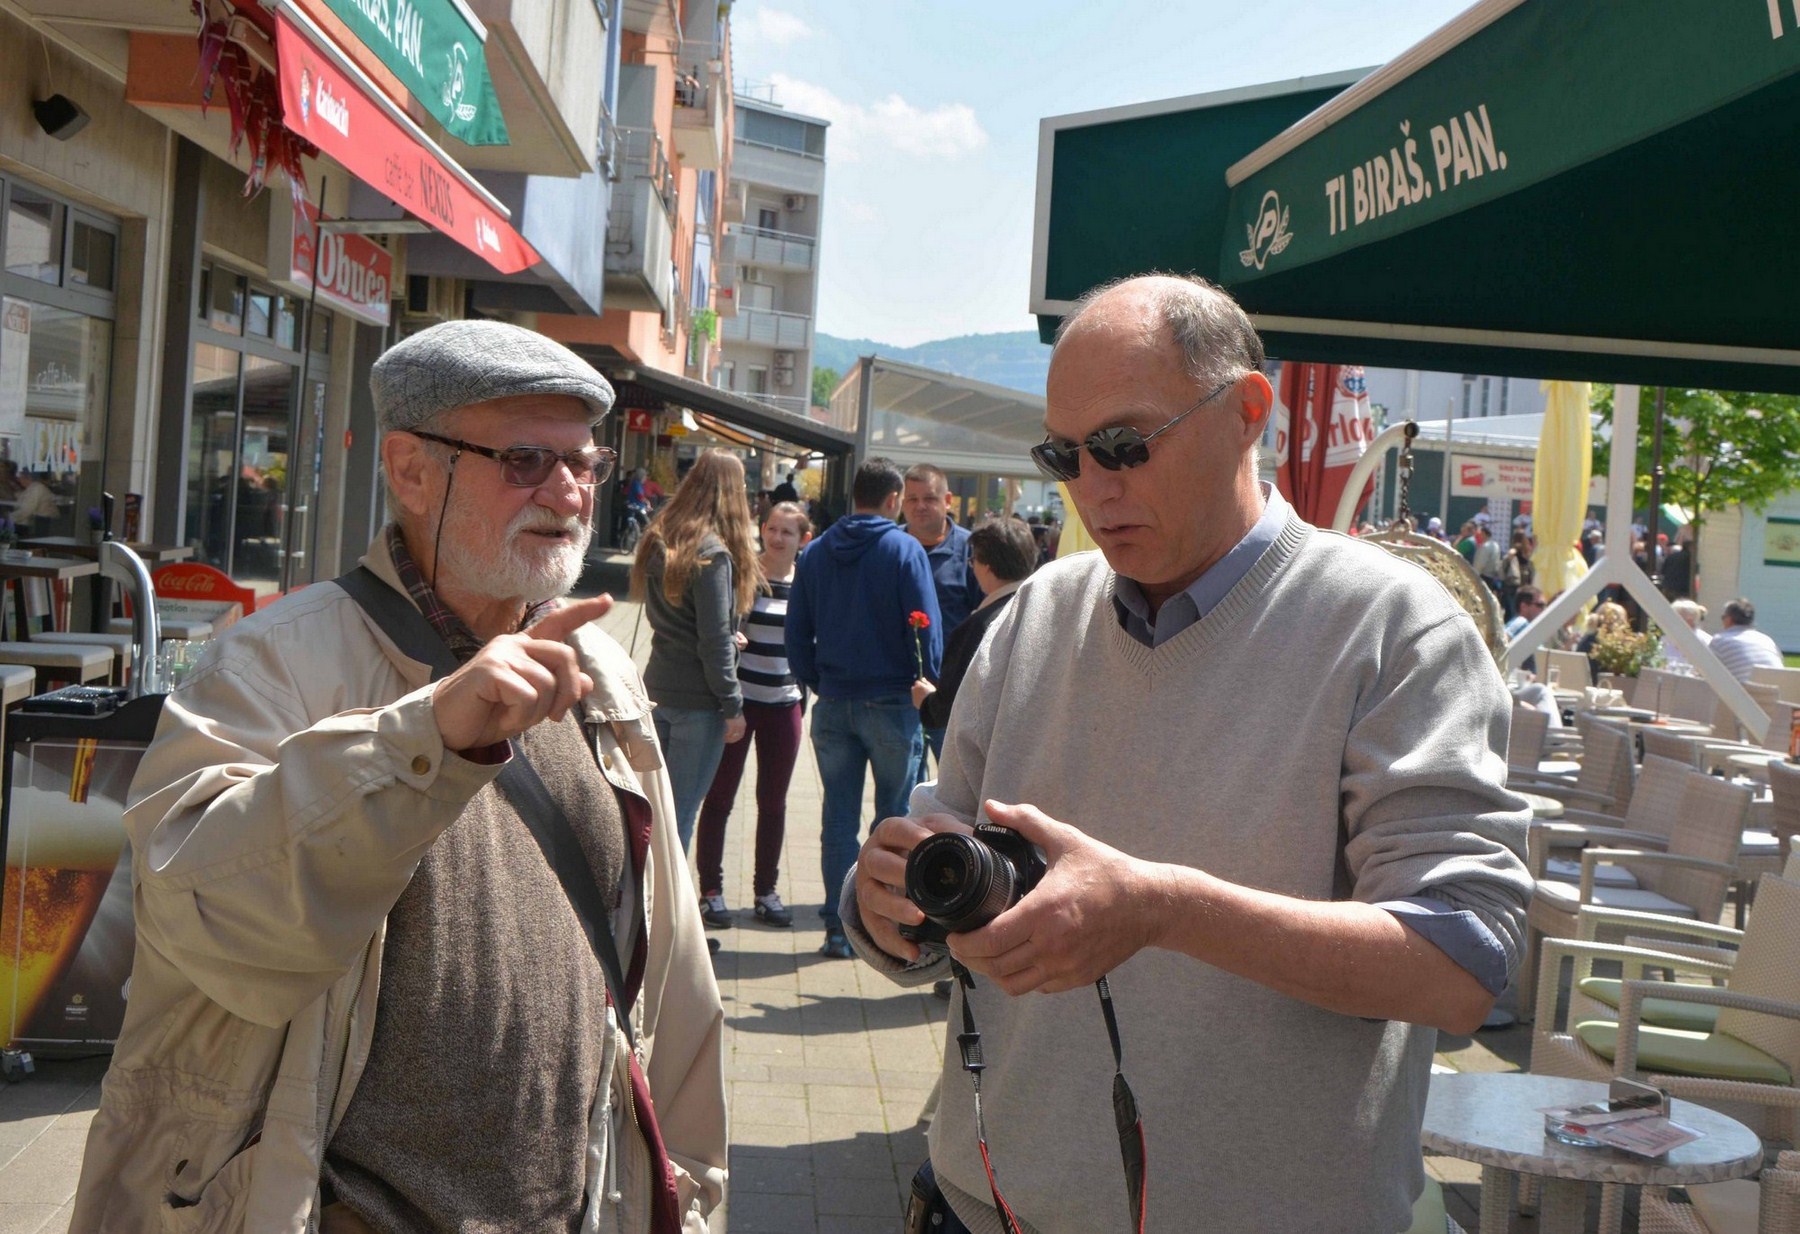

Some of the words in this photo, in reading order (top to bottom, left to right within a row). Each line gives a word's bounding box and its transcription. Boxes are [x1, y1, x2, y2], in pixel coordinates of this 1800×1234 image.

[420, 158, 454, 228] NEXUS
[1325, 175, 1347, 236] TI
[1352, 119, 1432, 226] BIRAŠ.
[1430, 104, 1507, 192] PAN.
[317, 227, 387, 309] Obuća
[978, 823, 1008, 834] Canon
